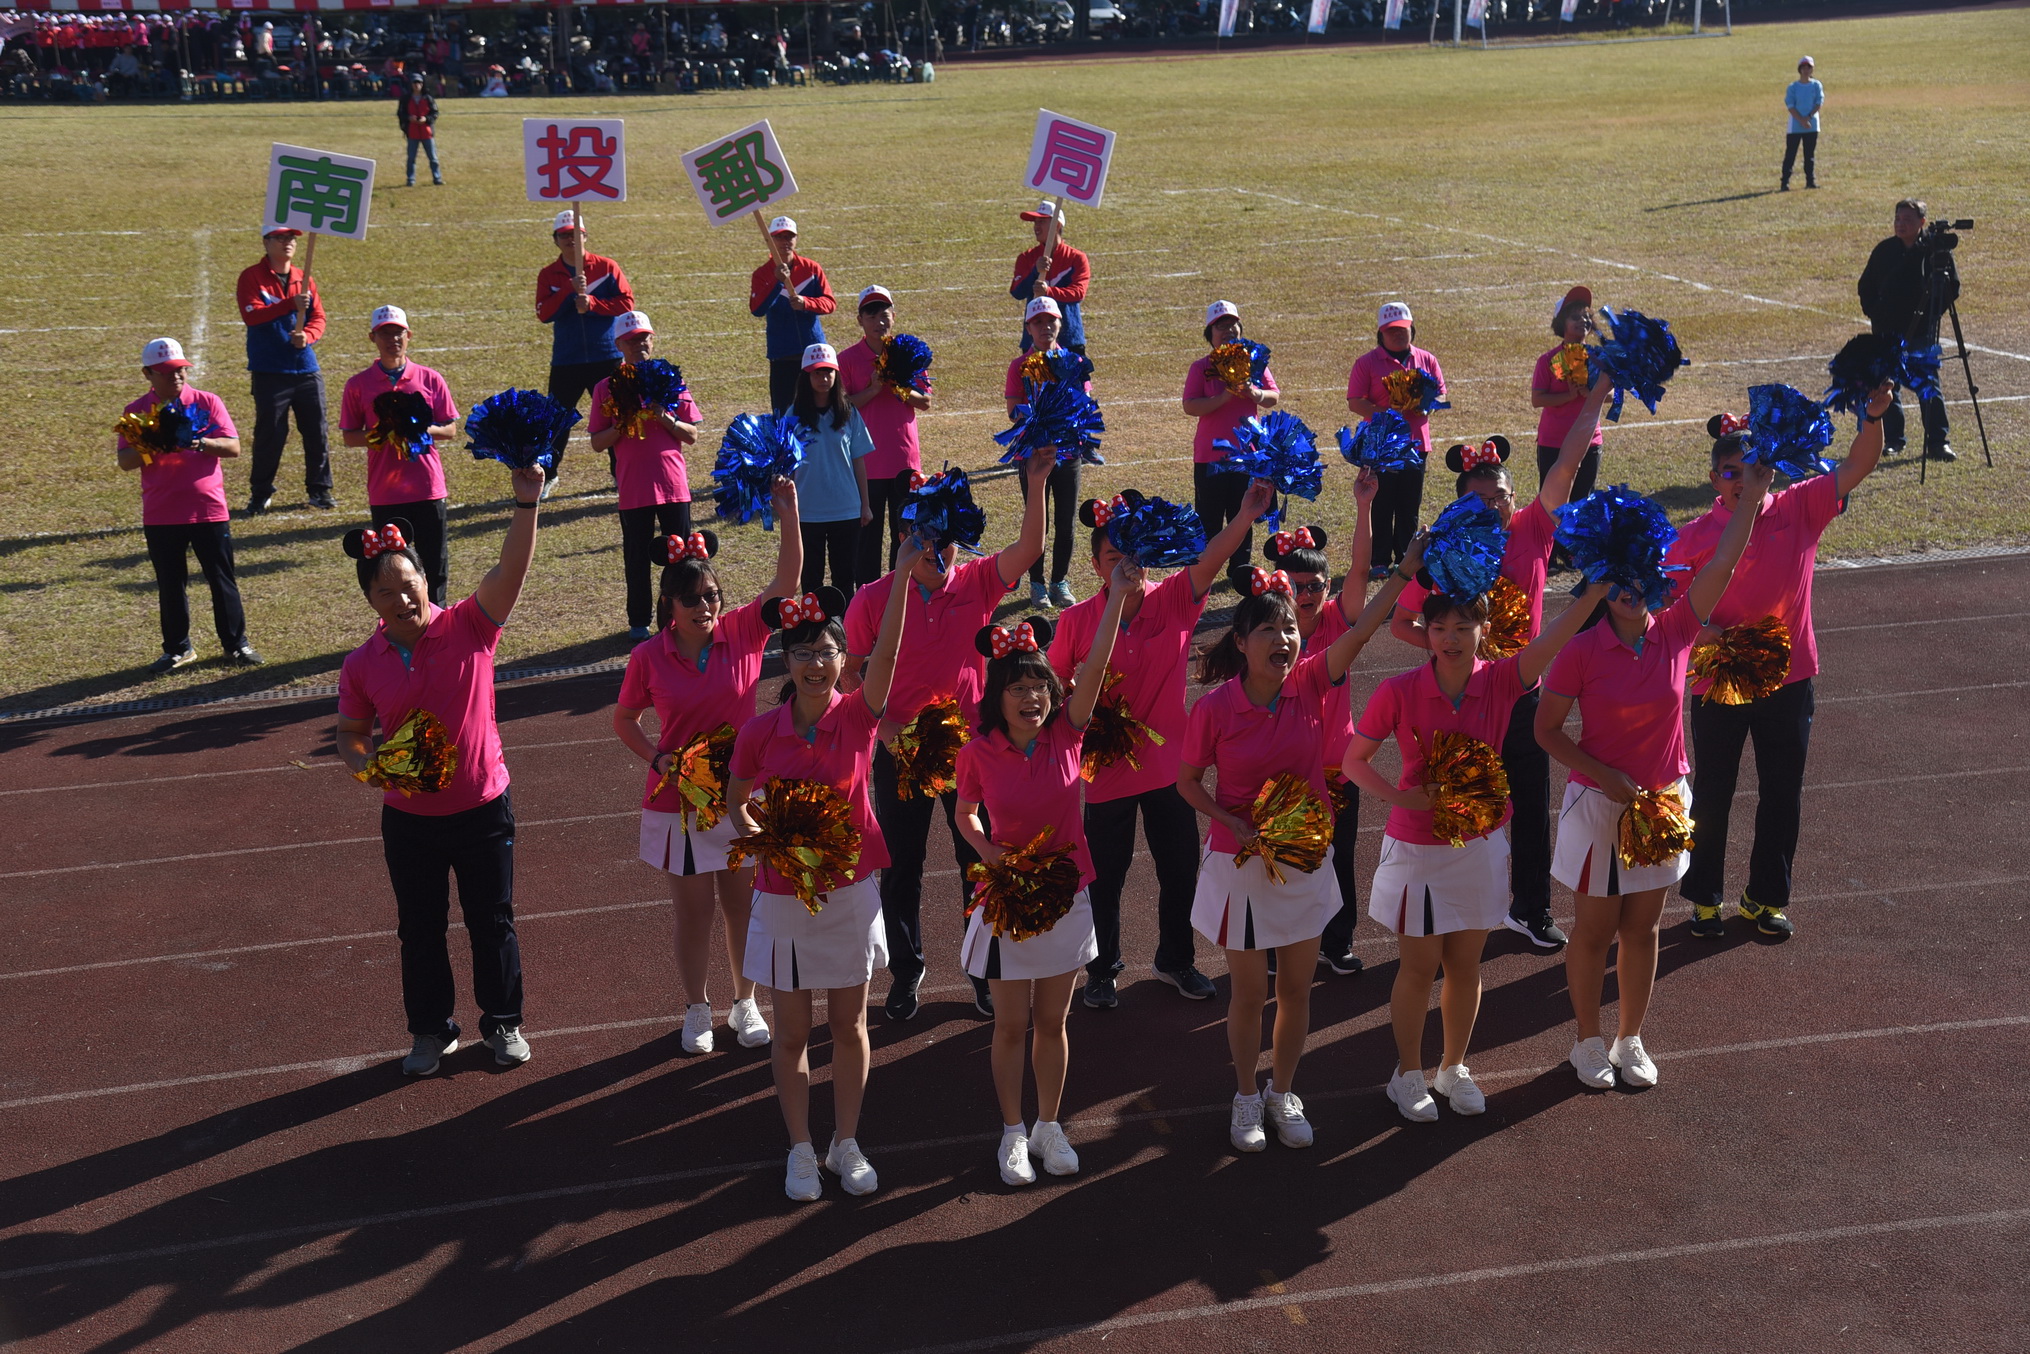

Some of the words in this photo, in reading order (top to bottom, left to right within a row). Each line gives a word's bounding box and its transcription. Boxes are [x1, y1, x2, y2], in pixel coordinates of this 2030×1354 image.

[275, 155, 369, 234] 南
[536, 124, 619, 198] 投
[694, 130, 784, 218] 郵
[1032, 119, 1106, 200] 局
